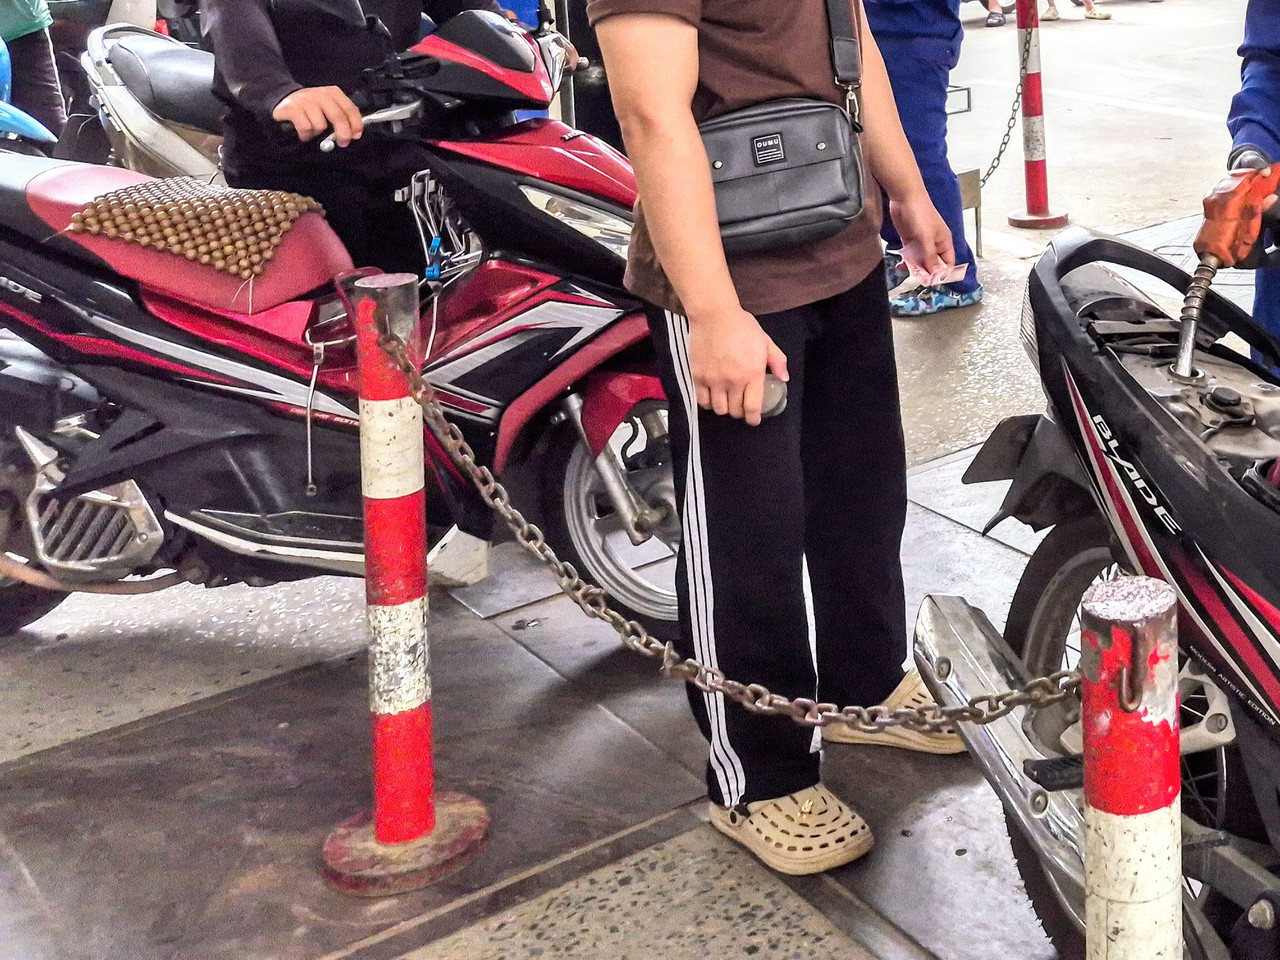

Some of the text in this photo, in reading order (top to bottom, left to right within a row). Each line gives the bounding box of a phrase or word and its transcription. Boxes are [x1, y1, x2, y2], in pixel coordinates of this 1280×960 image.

[1093, 415, 1182, 535] BLADE
[1218, 673, 1247, 700] ARTISTIC
[1247, 699, 1276, 726] EDITION
